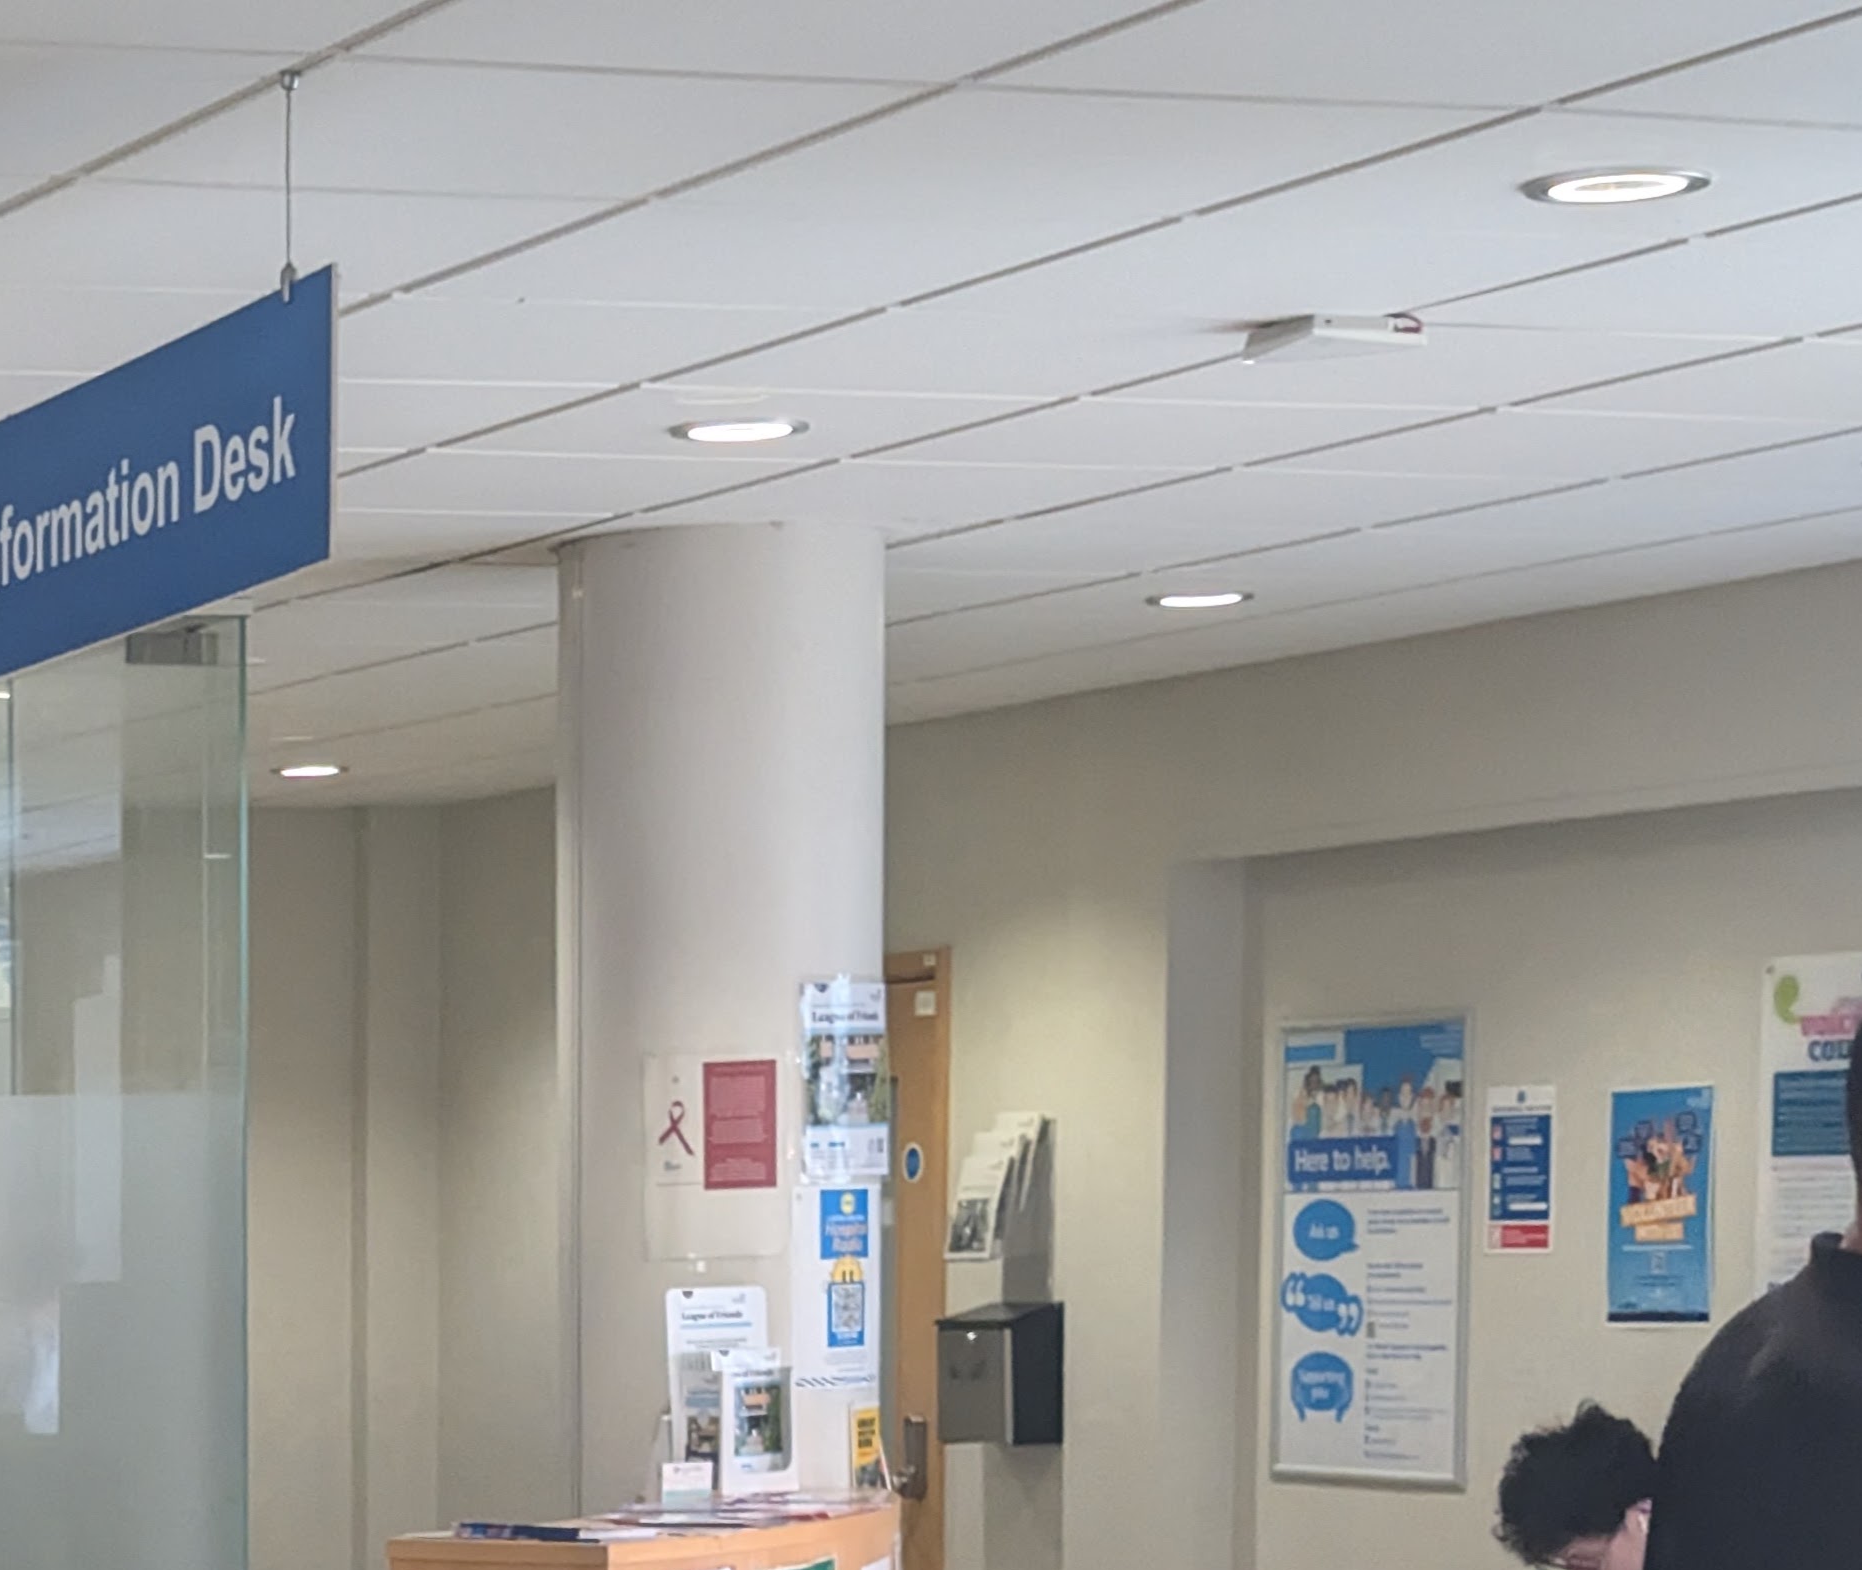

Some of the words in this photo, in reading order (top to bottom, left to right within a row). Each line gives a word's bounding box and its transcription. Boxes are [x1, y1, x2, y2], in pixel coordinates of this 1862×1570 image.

[193, 395, 296, 513] Desk
[1294, 1149, 1329, 1172] Here
[1332, 1149, 1351, 1171] to
